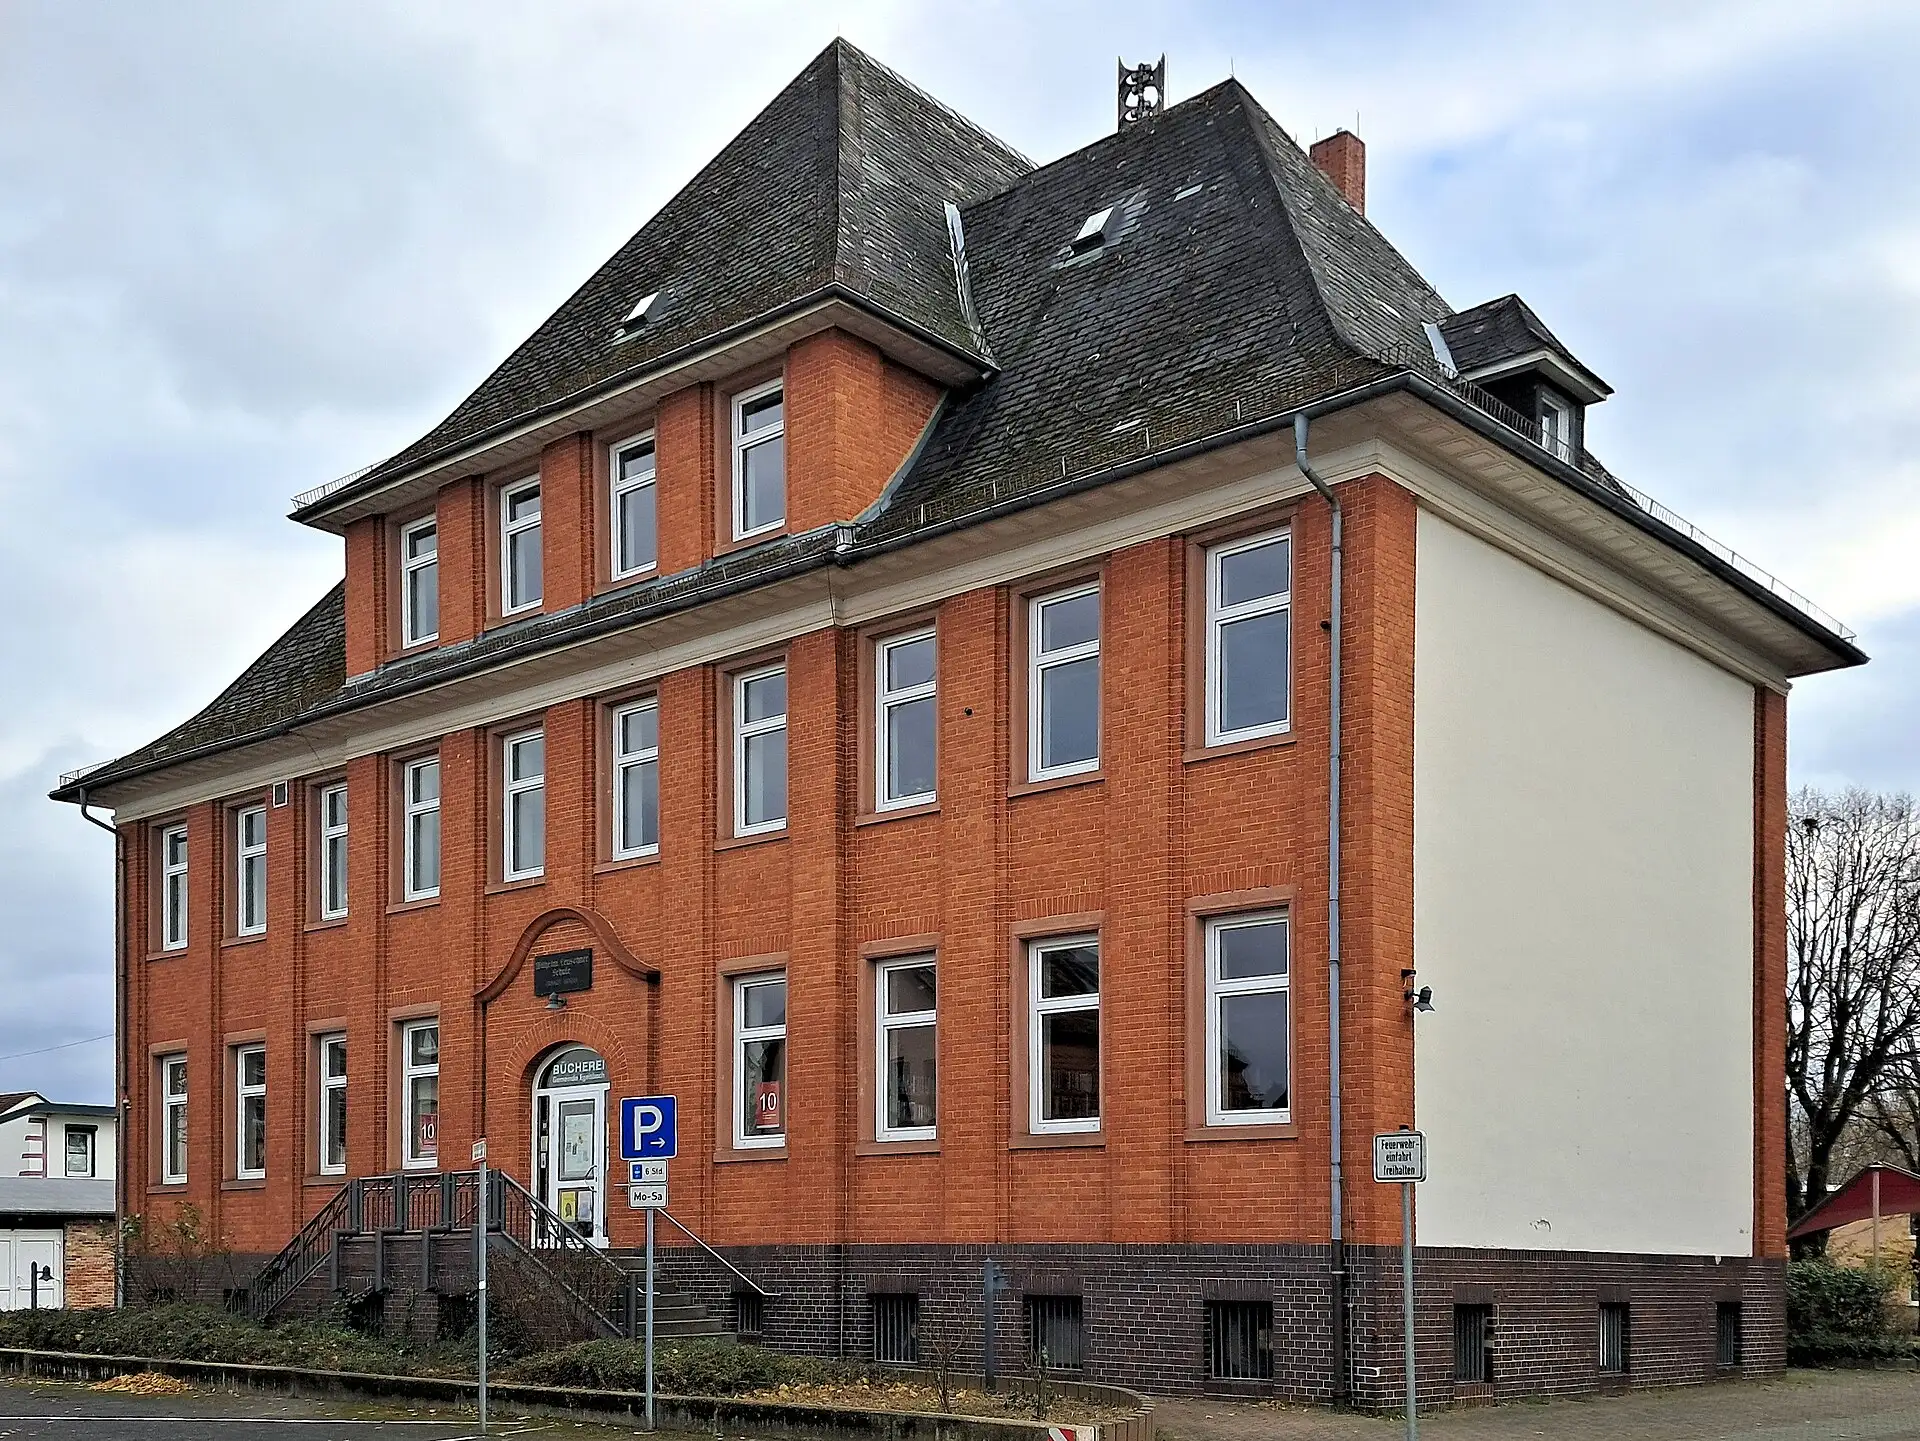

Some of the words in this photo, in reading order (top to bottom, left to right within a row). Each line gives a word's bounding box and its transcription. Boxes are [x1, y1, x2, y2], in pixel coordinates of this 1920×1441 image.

[553, 1060, 605, 1075] BÜCHEREI
[759, 1092, 777, 1111] 10
[421, 1123, 435, 1139] 10
[634, 1105, 663, 1151] P
[1381, 1139, 1420, 1150] Feuerwehr-
[1385, 1150, 1412, 1162] einfahrt
[645, 1167, 650, 1176] 6
[1383, 1165, 1416, 1176] freihalten
[633, 1191, 663, 1201] Mo-Sa
